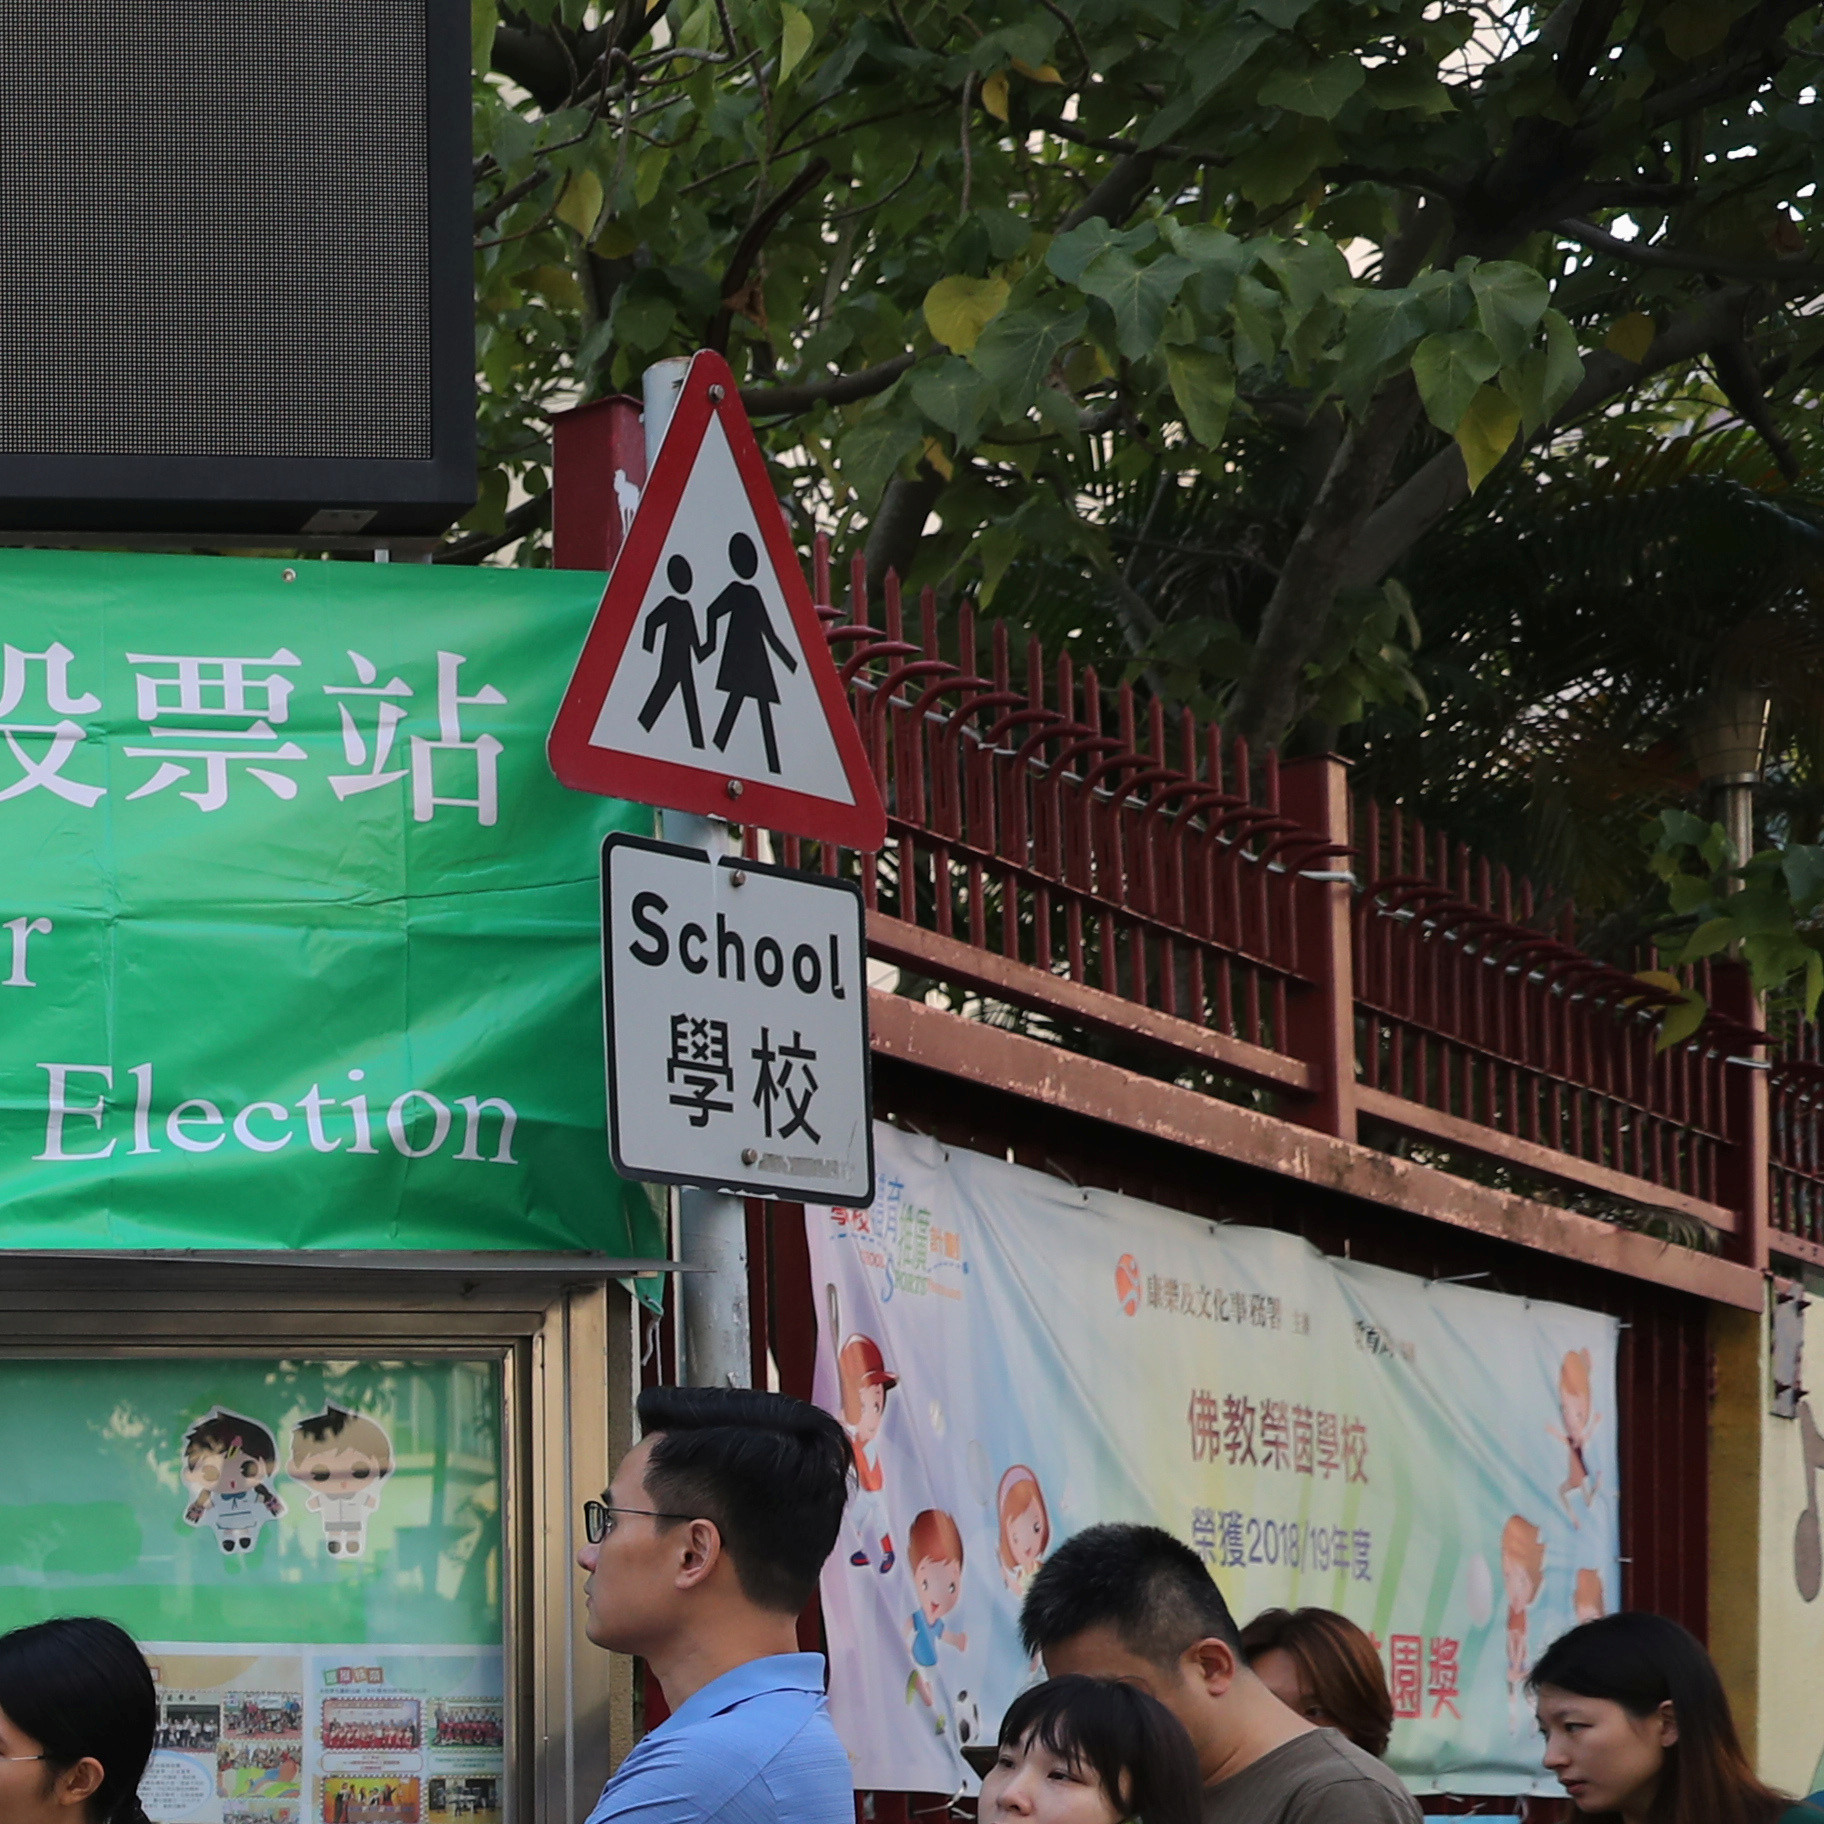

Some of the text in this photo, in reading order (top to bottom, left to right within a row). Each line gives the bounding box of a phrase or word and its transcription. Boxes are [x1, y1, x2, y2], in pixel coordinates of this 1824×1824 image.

[628, 890, 846, 1001] School
[30, 1061, 518, 1162] Election
[666, 1012, 822, 1146] 學校
[1188, 1388, 1369, 1484] 佛教榮茵學校
[1368, 1632, 1463, 1720] 園獎
